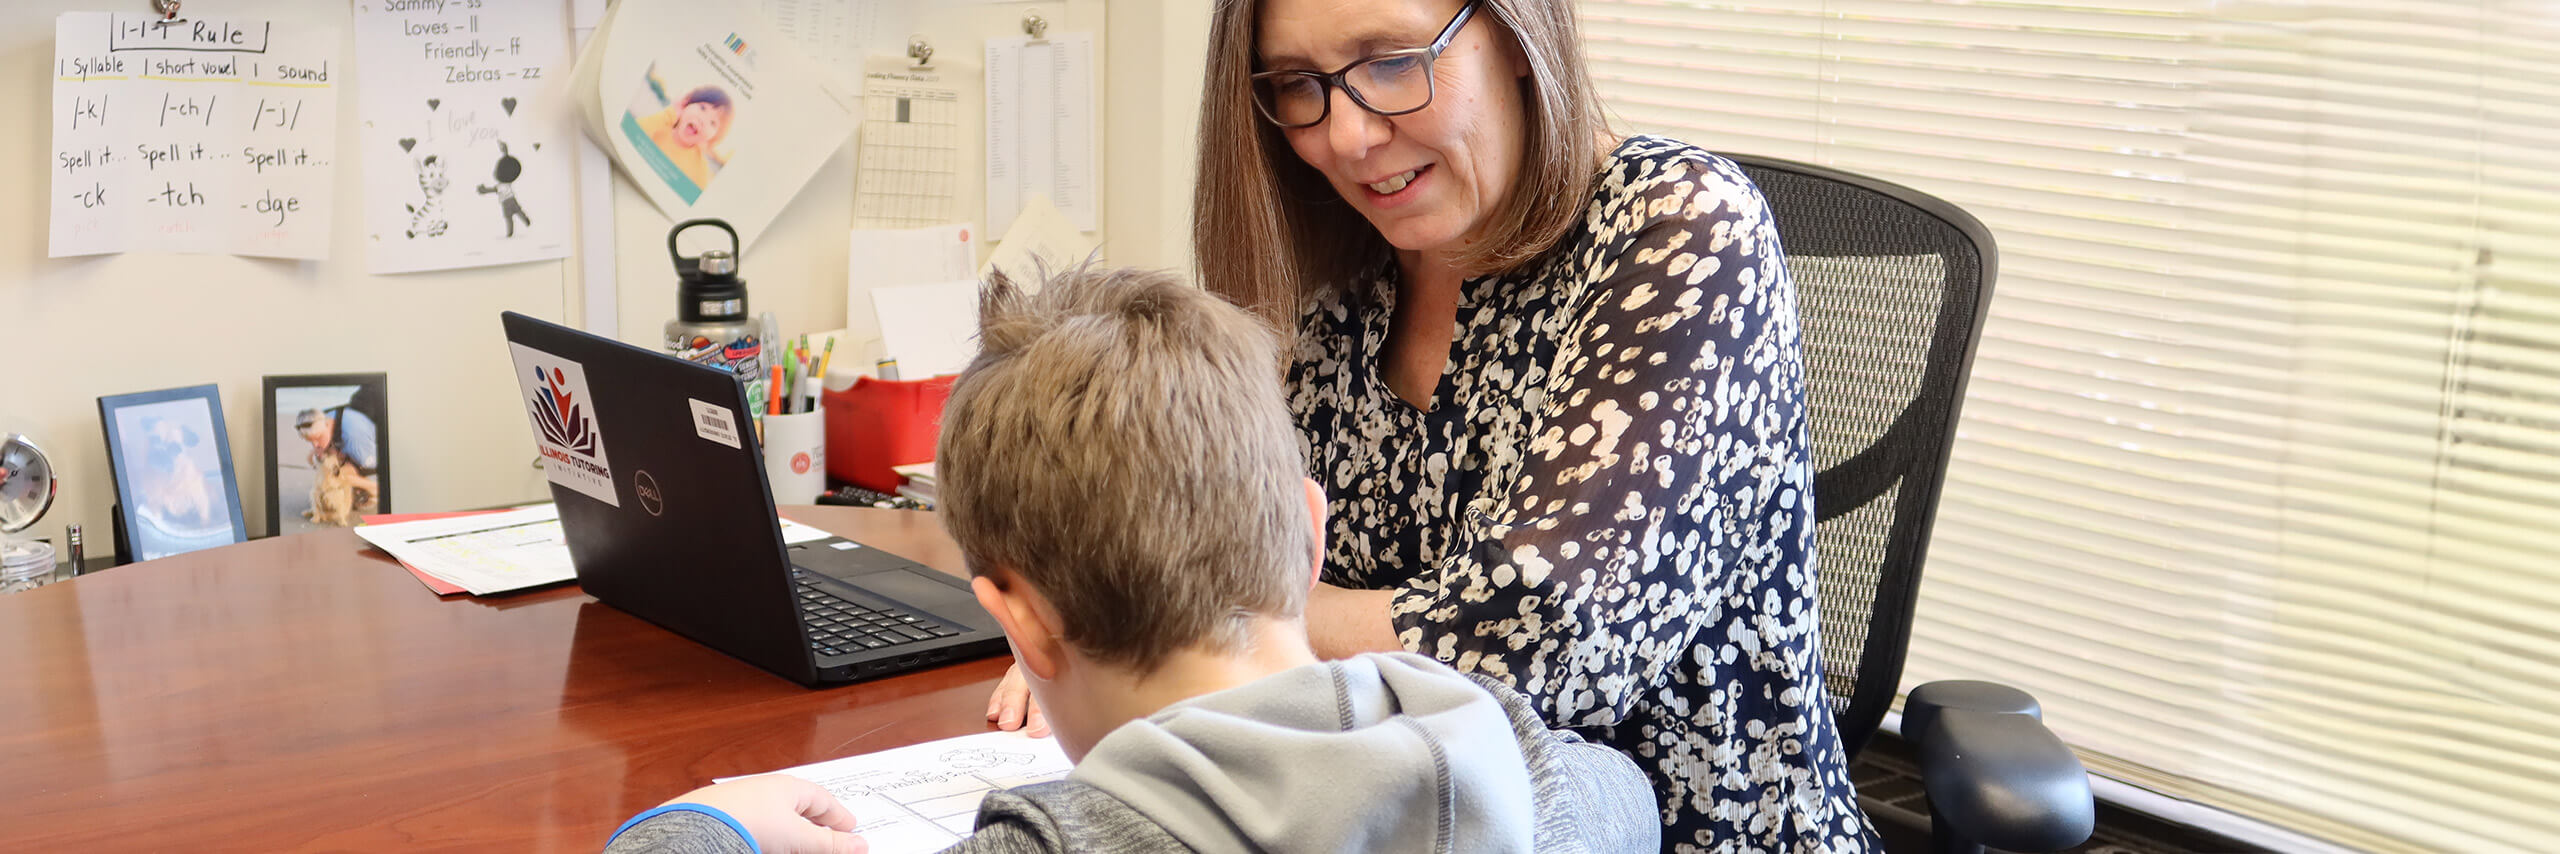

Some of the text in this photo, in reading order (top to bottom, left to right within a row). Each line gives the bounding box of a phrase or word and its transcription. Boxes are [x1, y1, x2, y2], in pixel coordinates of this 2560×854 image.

[384, 0, 445, 14] Sammy
[192, 20, 244, 44] Rule
[404, 19, 449, 36] Loves
[424, 39, 490, 62] Friendly
[510, 36, 521, 56] ff
[73, 56, 125, 83] Syllable
[156, 59, 195, 77] short
[201, 55, 237, 77] vowel
[278, 59, 328, 83] sound
[445, 65, 501, 83] Zebras
[59, 150, 92, 174] Spell
[138, 143, 180, 171] Spell
[243, 147, 286, 174] Spell
[540, 444, 610, 479] ILLINOIS TUTORING
[554, 463, 602, 487] INITIATIVE
[638, 485, 660, 501] DELL
